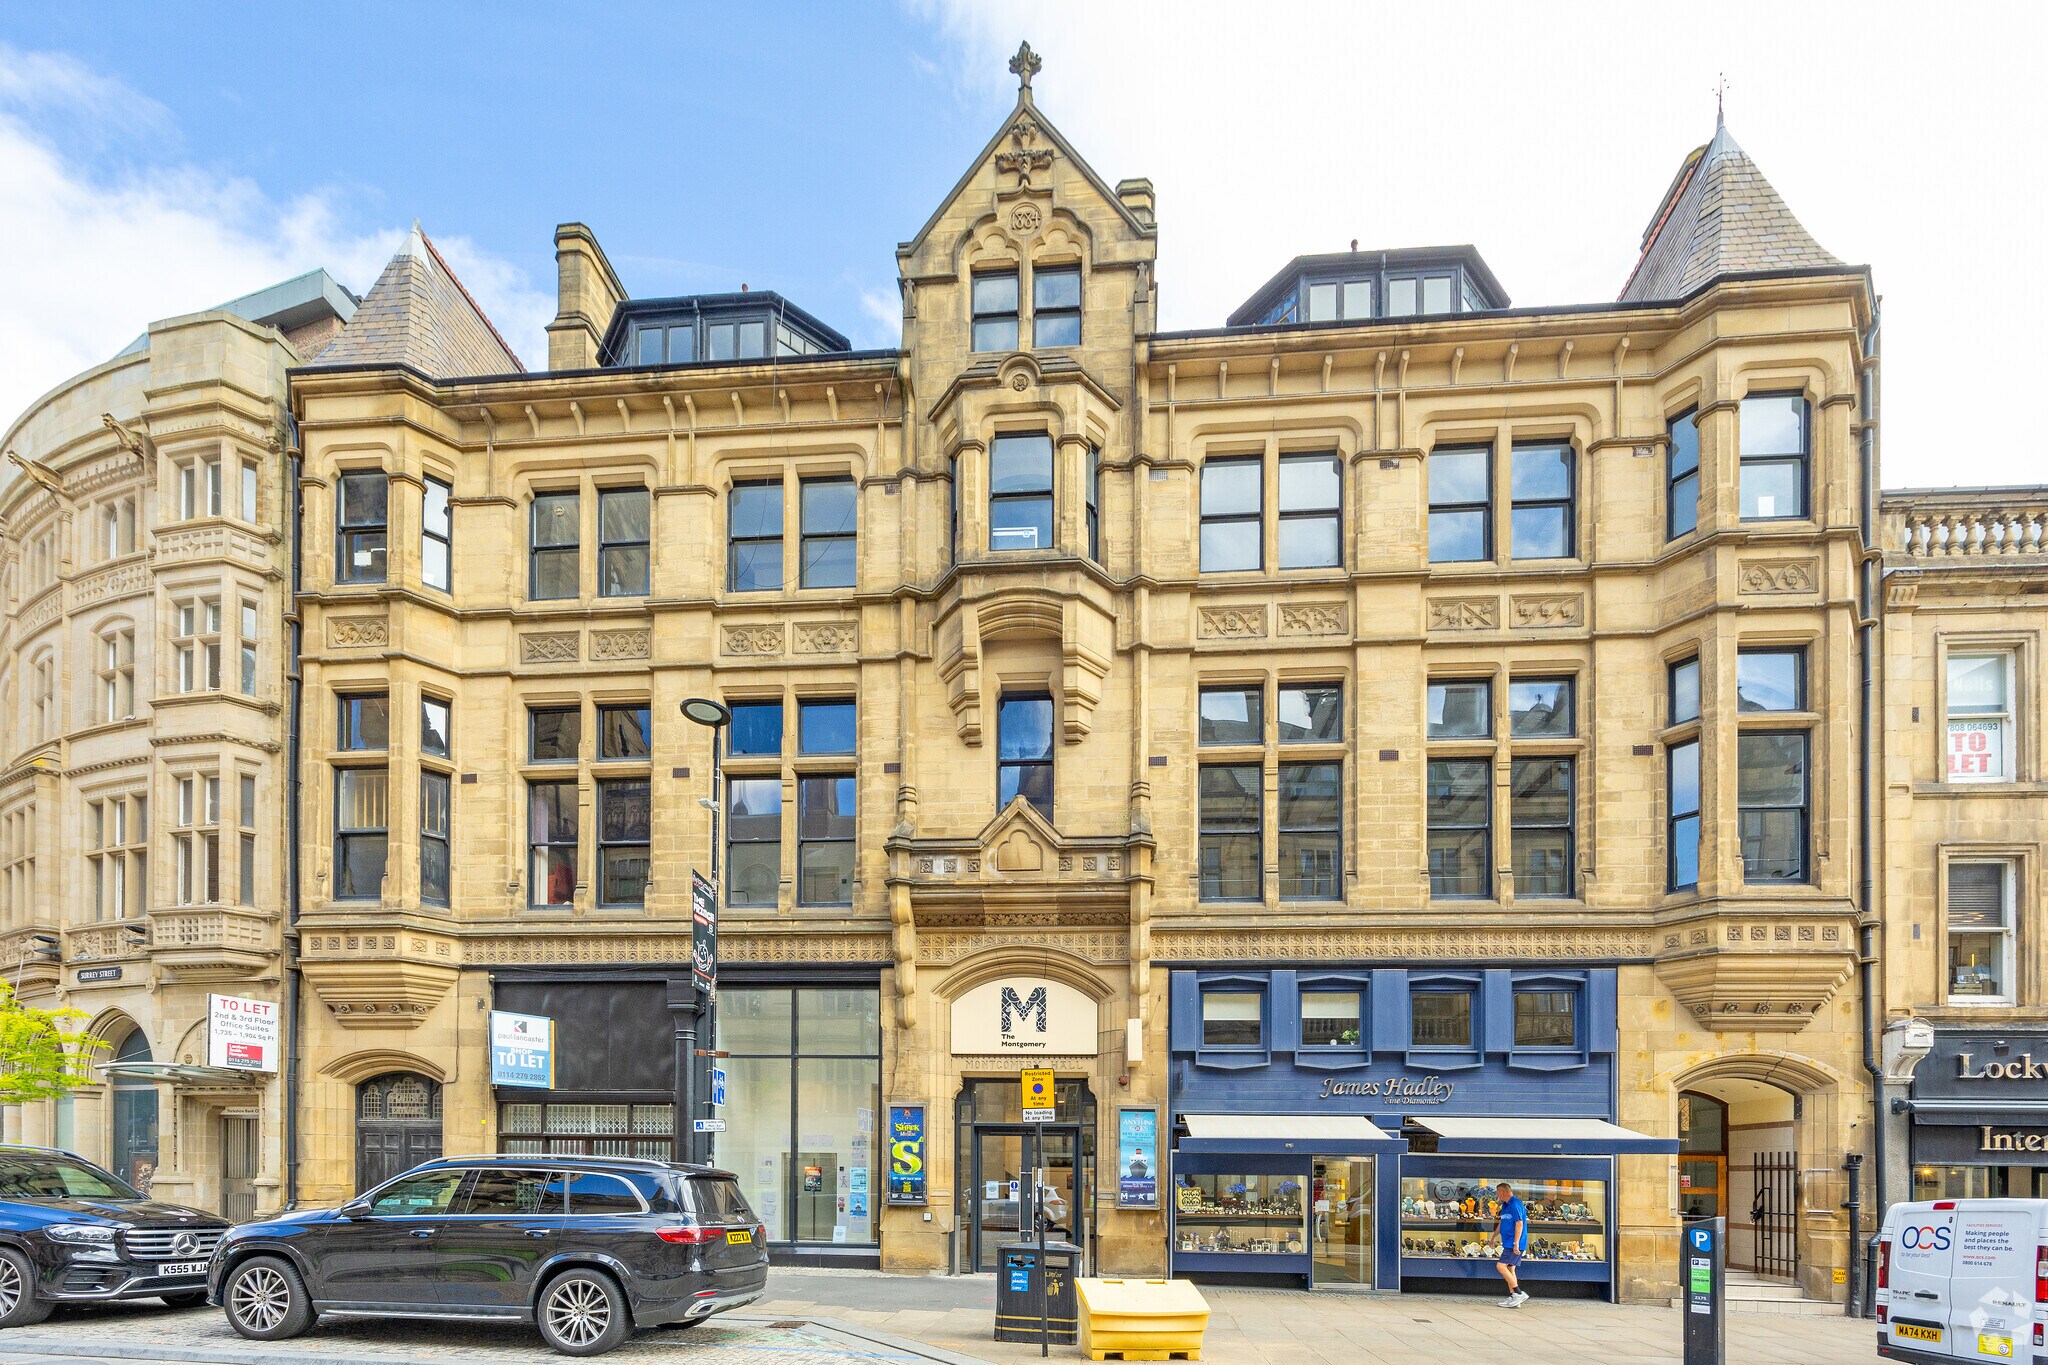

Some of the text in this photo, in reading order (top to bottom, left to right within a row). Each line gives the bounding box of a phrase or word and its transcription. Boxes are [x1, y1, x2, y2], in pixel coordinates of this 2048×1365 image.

[1012, 211, 1040, 229] 1884
[1947, 722, 1998, 731] 808 064693
[1951, 733, 1987, 752] TO
[1947, 753, 1992, 773] LET
[80, 969, 117, 980] SURREY STREET
[220, 998, 271, 1016] TO LET
[1001, 987, 1047, 1033] M
[214, 1011, 275, 1026] 2nd & 3rd Floor
[220, 1020, 270, 1033] Office Suites
[214, 1028, 233, 1037] 1,735
[239, 1031, 257, 1040] 1,904
[258, 1034, 266, 1042] Sq
[510, 1047, 533, 1055] SHOP
[498, 1052, 545, 1069] TO LET
[965, 1059, 1083, 1070] MONTGOMERY HALL
[1957, 1053, 2048, 1079] Lock
[498, 1071, 546, 1082] 0114 279 2852
[1320, 1075, 1455, 1103] James Hadley
[1384, 1096, 1440, 1104] Fine Diamonds
[1695, 1232, 1708, 1248] P
[1902, 1226, 1951, 1251] OCS
[163, 1263, 207, 1274] K555 WJA
[1992, 1300, 2027, 1308] RENAULT
[1898, 1325, 1938, 1341] MA74 KXH
